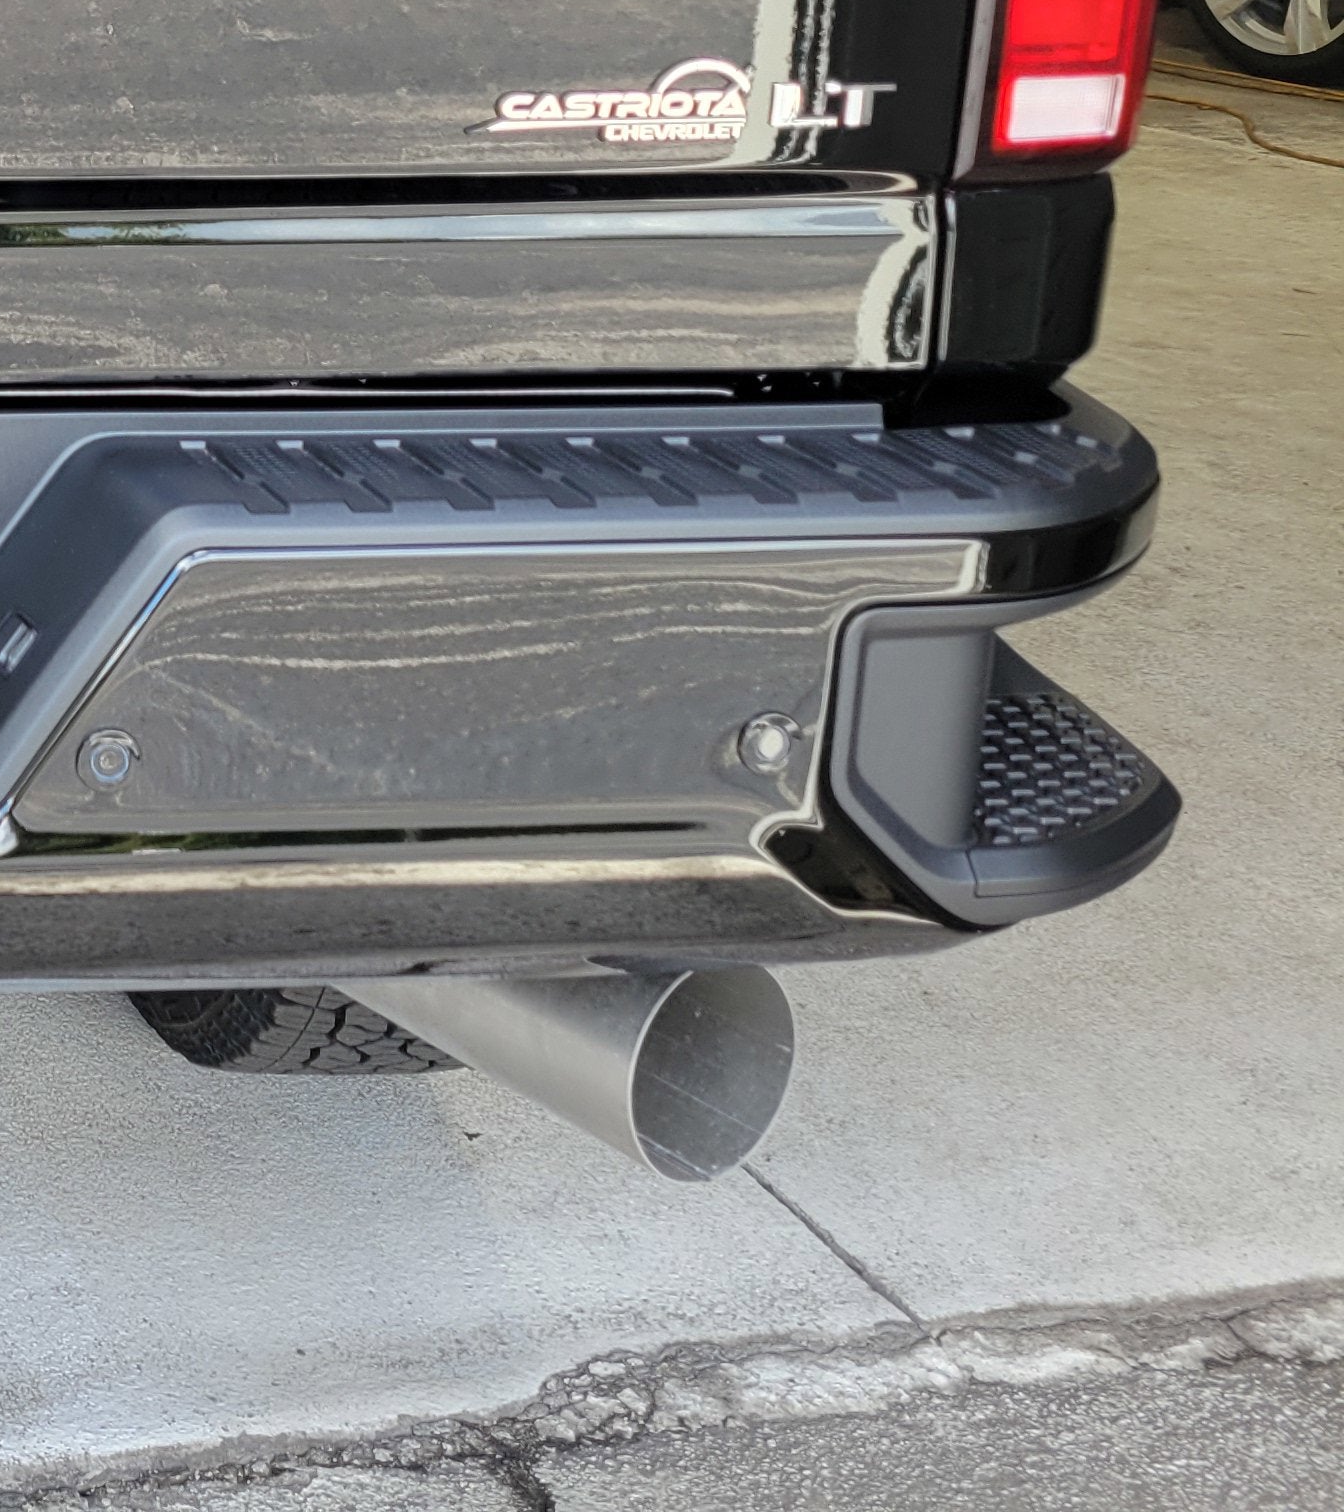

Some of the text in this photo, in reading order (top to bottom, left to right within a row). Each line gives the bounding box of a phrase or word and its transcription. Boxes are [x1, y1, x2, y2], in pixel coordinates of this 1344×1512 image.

[498, 90, 749, 119] CASTRIOTA
[770, 82, 897, 128] LT
[604, 122, 743, 141] CHEVROLET
